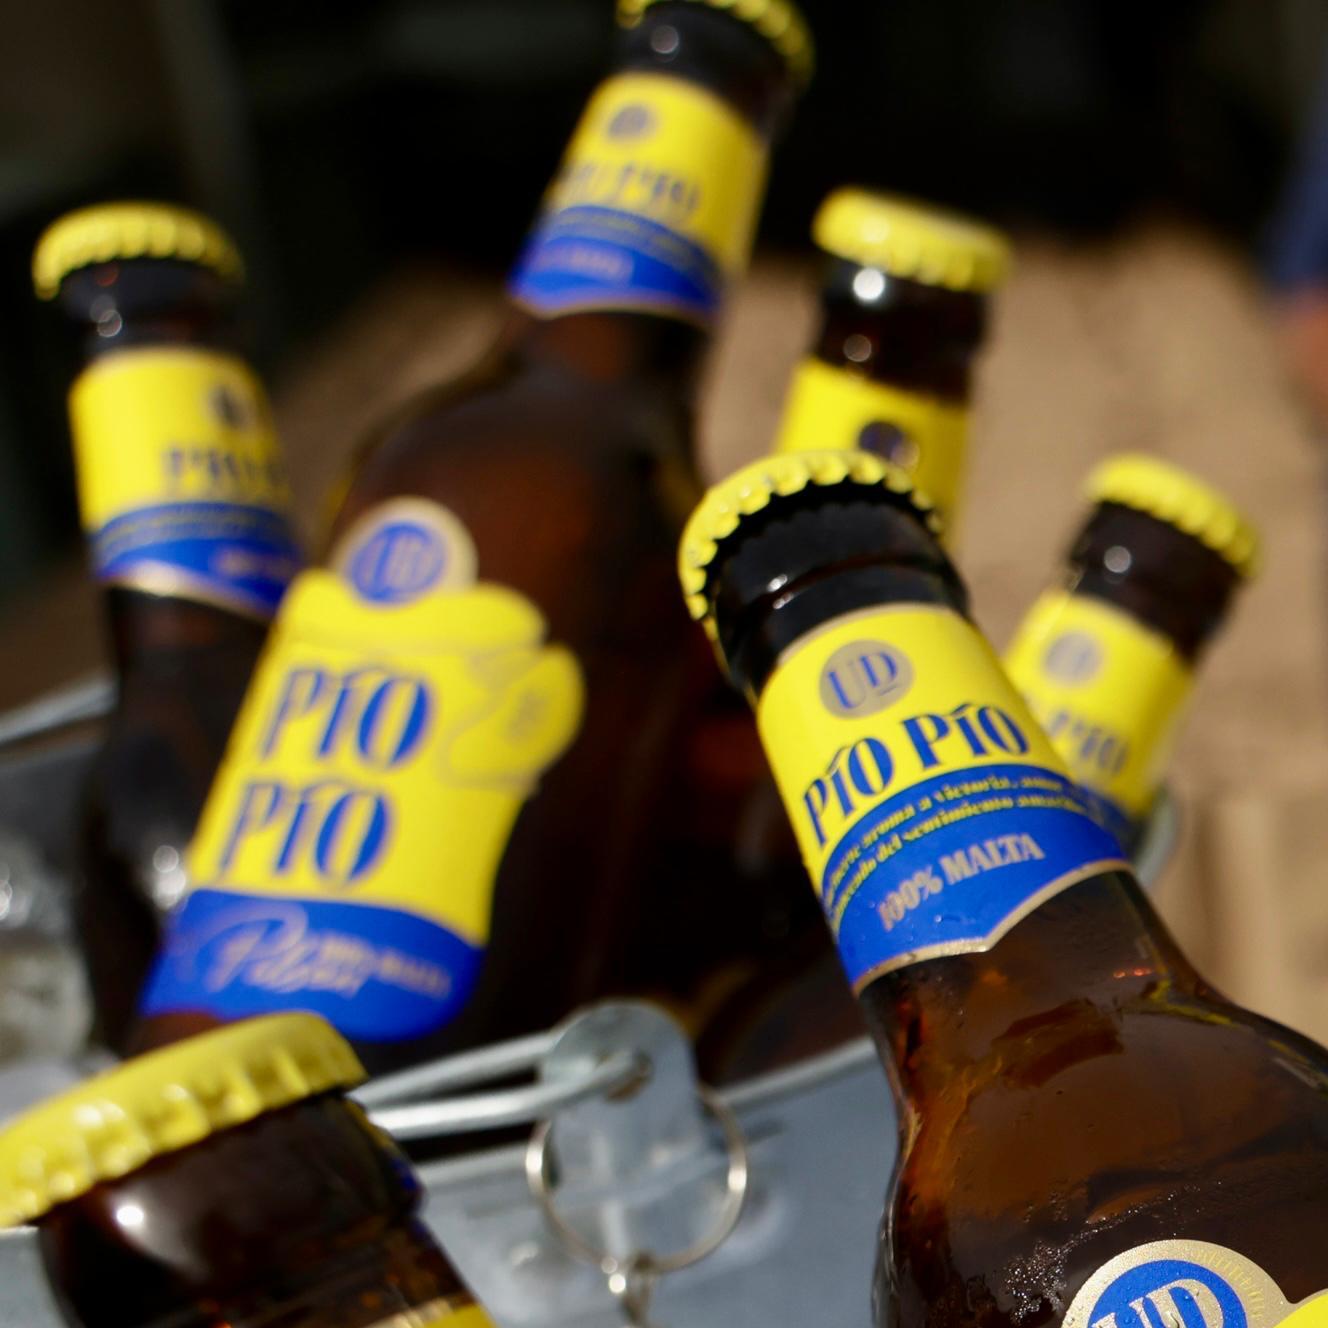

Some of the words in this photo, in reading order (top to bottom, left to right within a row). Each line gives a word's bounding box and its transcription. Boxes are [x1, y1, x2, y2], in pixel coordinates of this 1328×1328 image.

[262, 664, 433, 770] PÍO
[828, 652, 899, 709] UD
[804, 737, 894, 848] PÍO
[900, 702, 1030, 771] PÍO
[919, 797, 932, 812] a
[219, 778, 393, 885] PÍO
[878, 866, 943, 932] 100%
[939, 833, 1045, 885] MALTA
